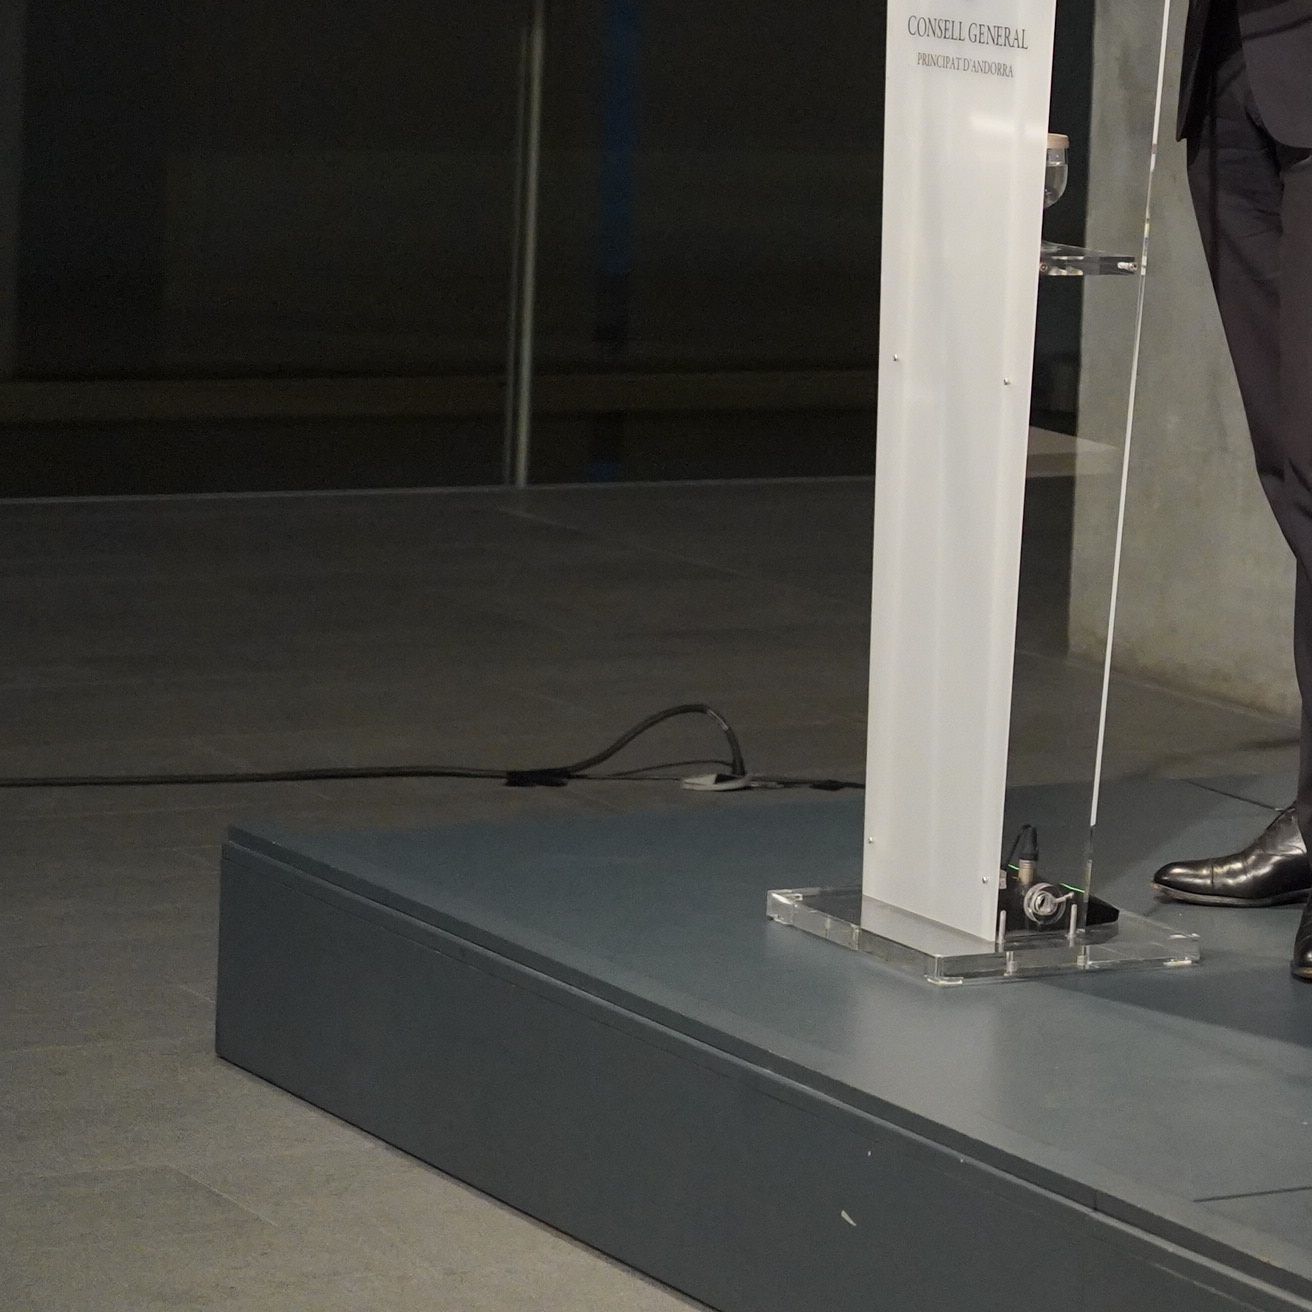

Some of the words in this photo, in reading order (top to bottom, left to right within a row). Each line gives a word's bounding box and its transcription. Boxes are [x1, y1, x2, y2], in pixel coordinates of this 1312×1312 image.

[907, 15, 966, 42] CONSELL
[968, 22, 1029, 50] GENERAL
[917, 52, 963, 71] PRINCIPAT
[963, 57, 1014, 78] D'ANDORRA
